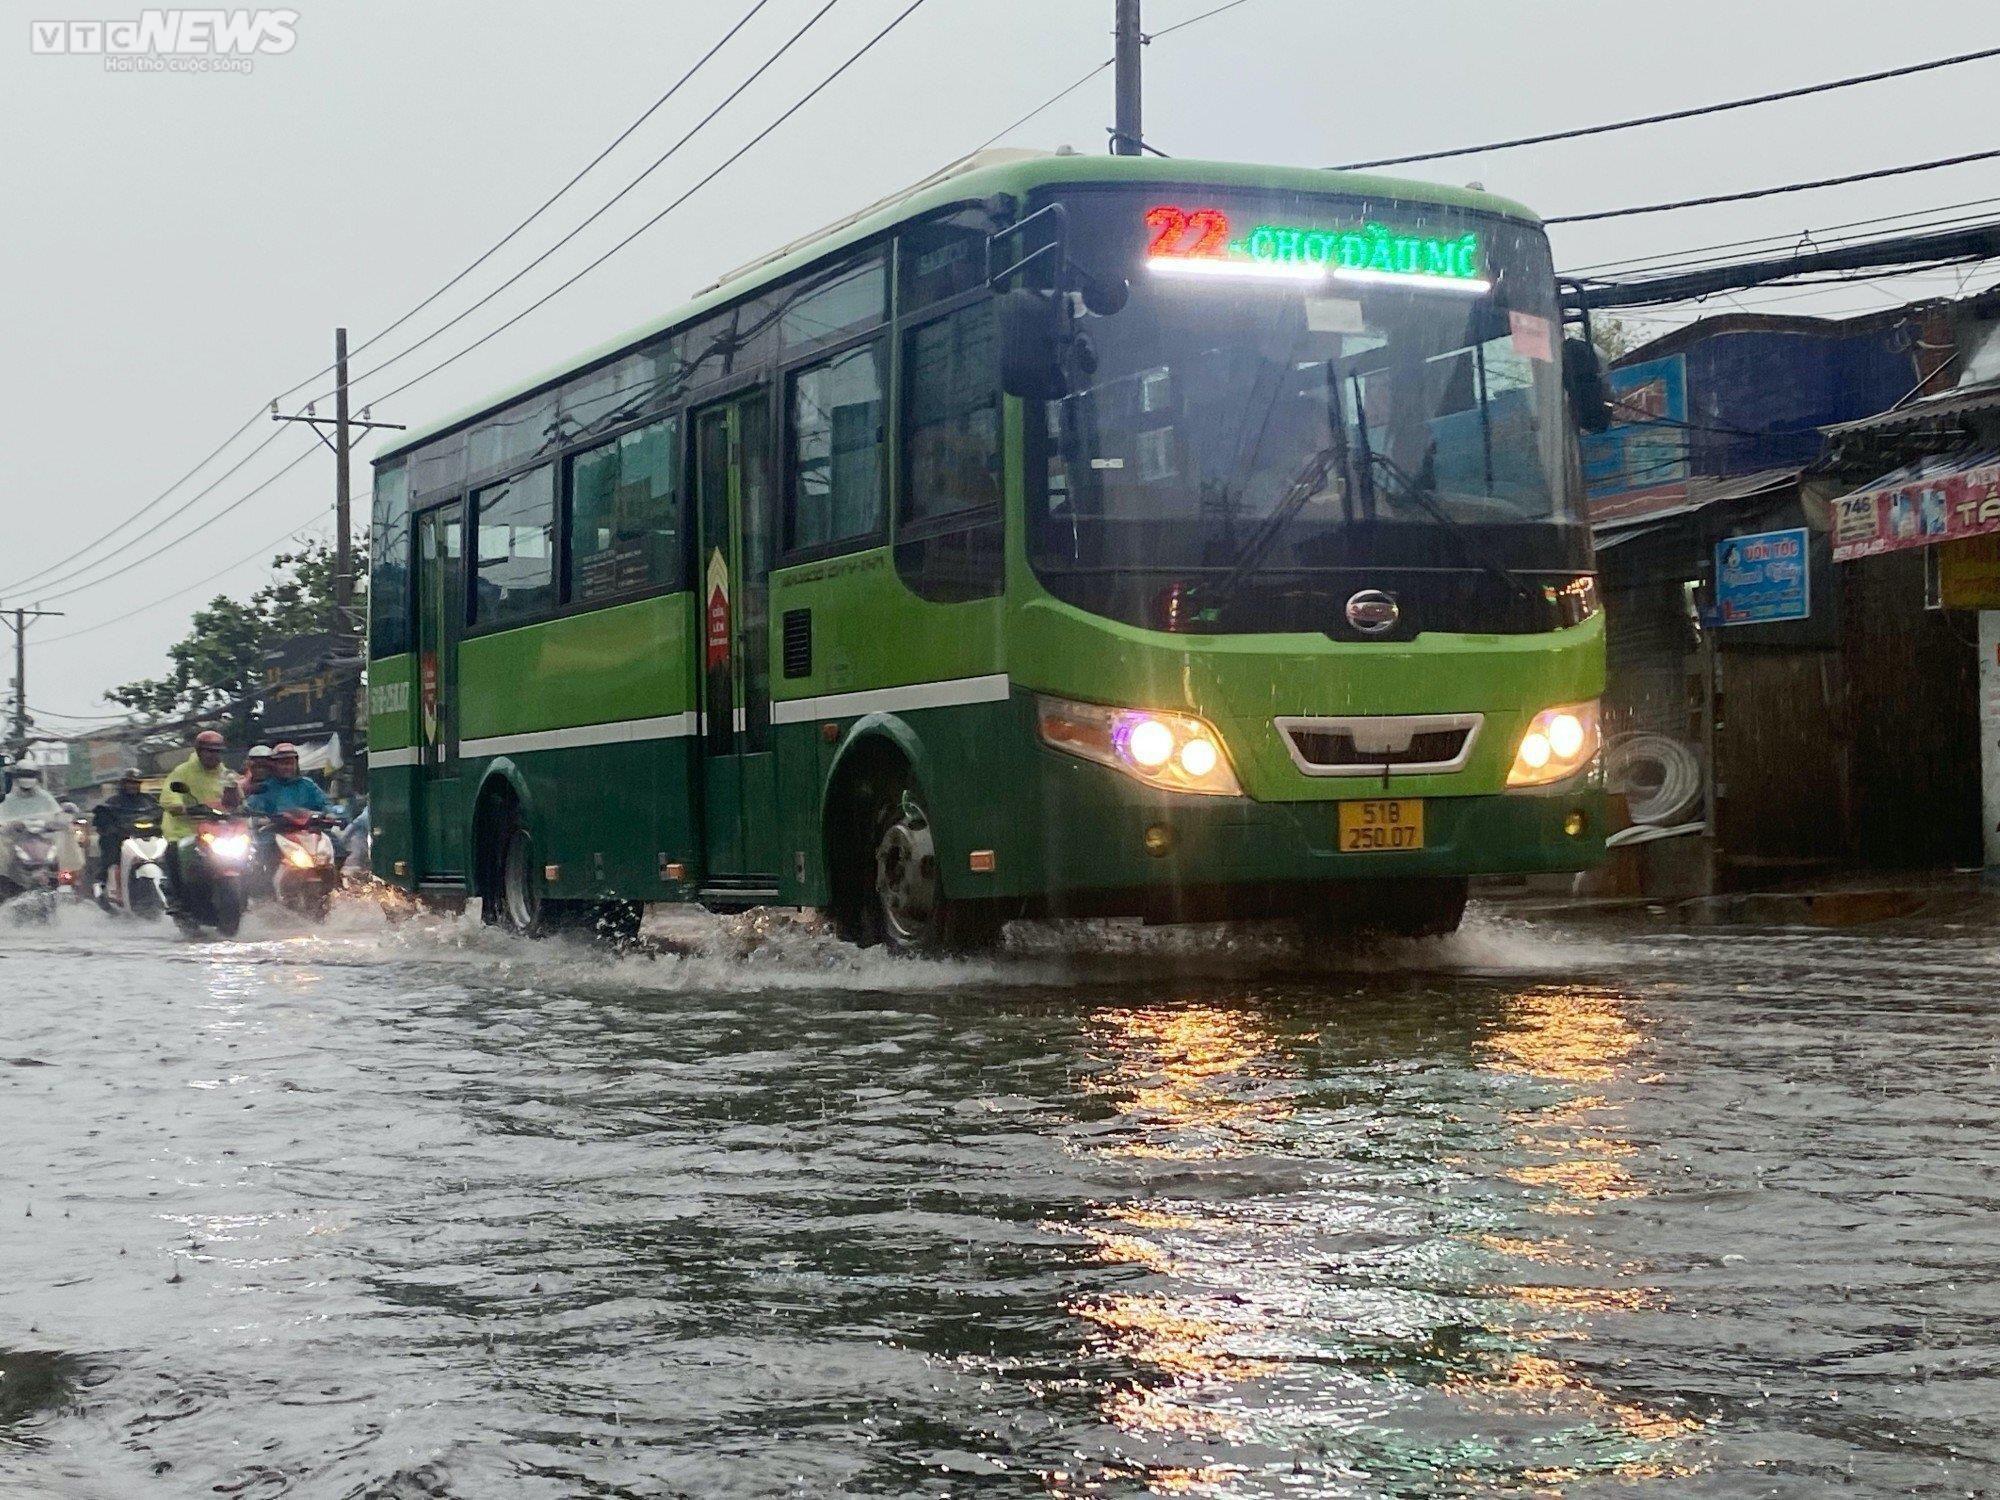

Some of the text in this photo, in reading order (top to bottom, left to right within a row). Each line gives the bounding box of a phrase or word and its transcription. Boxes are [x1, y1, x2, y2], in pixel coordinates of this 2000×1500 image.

[1146, 206, 1228, 257] 22
[1840, 496, 1872, 517] 746
[1363, 802, 1400, 824] 51B
